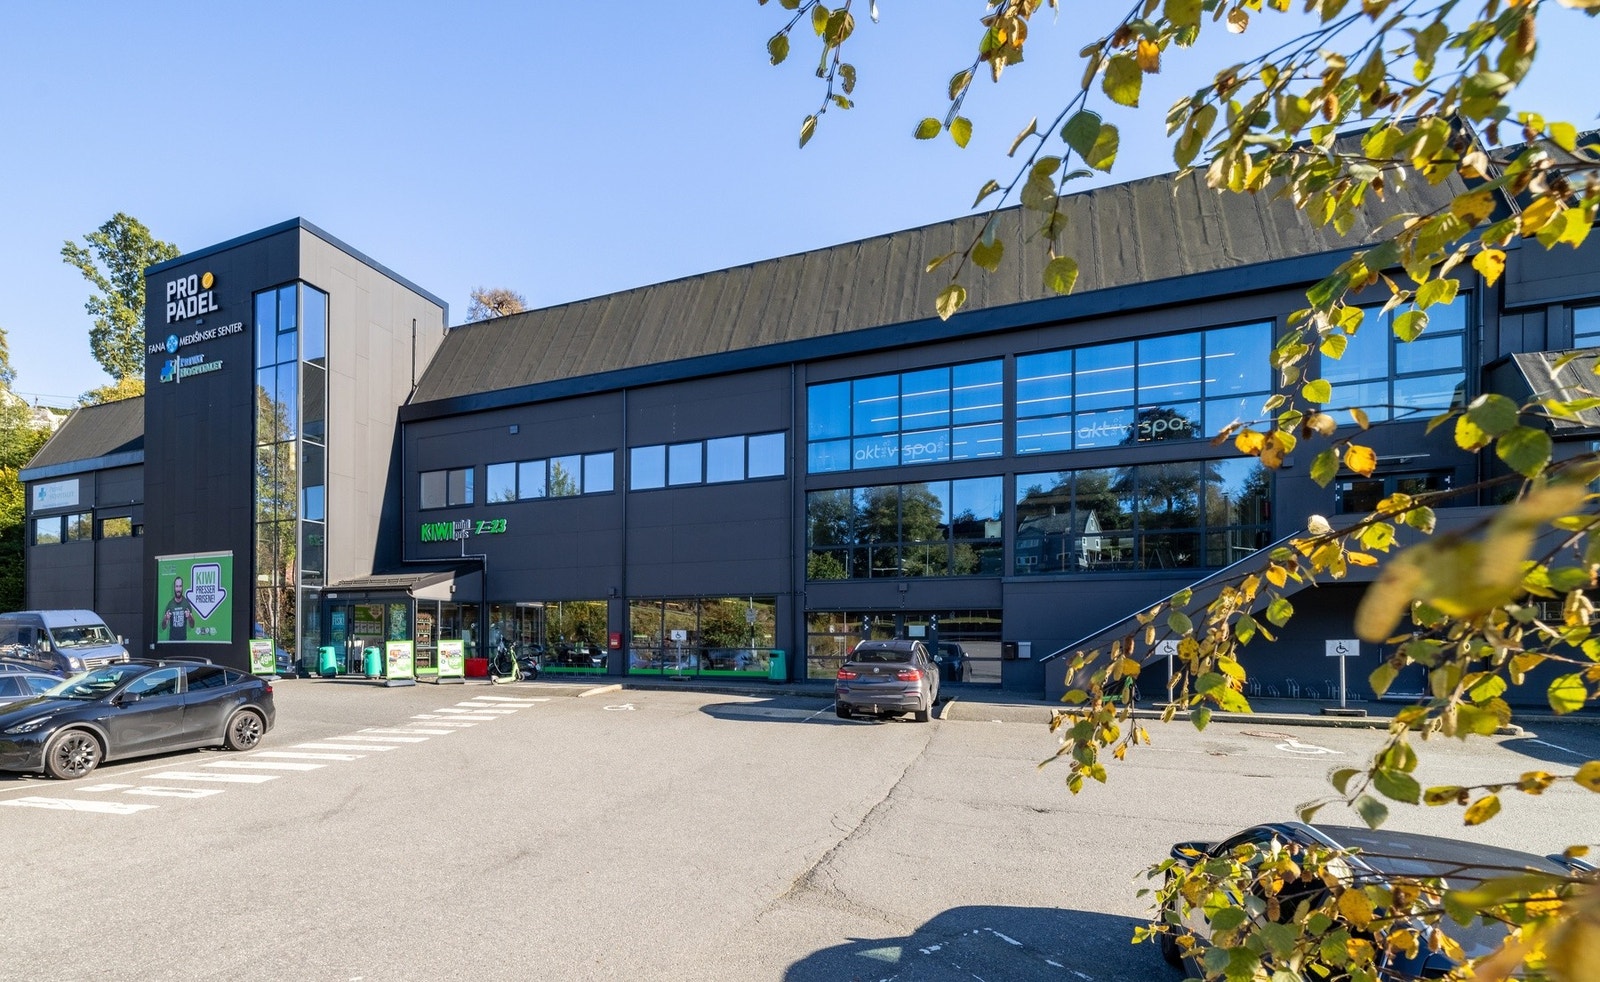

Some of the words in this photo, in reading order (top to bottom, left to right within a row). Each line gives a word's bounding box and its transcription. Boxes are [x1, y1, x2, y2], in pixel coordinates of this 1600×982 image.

[166, 274, 198, 303] PRO
[166, 290, 218, 324] PADEL
[148, 342, 166, 354] FANA
[218, 322, 242, 336] SENTER
[1140, 417, 1183, 438] spa
[903, 442, 937, 459] spa
[421, 521, 456, 543] KIWI
[196, 571, 215, 584] KIWI
[196, 585, 215, 594] PRESSER
